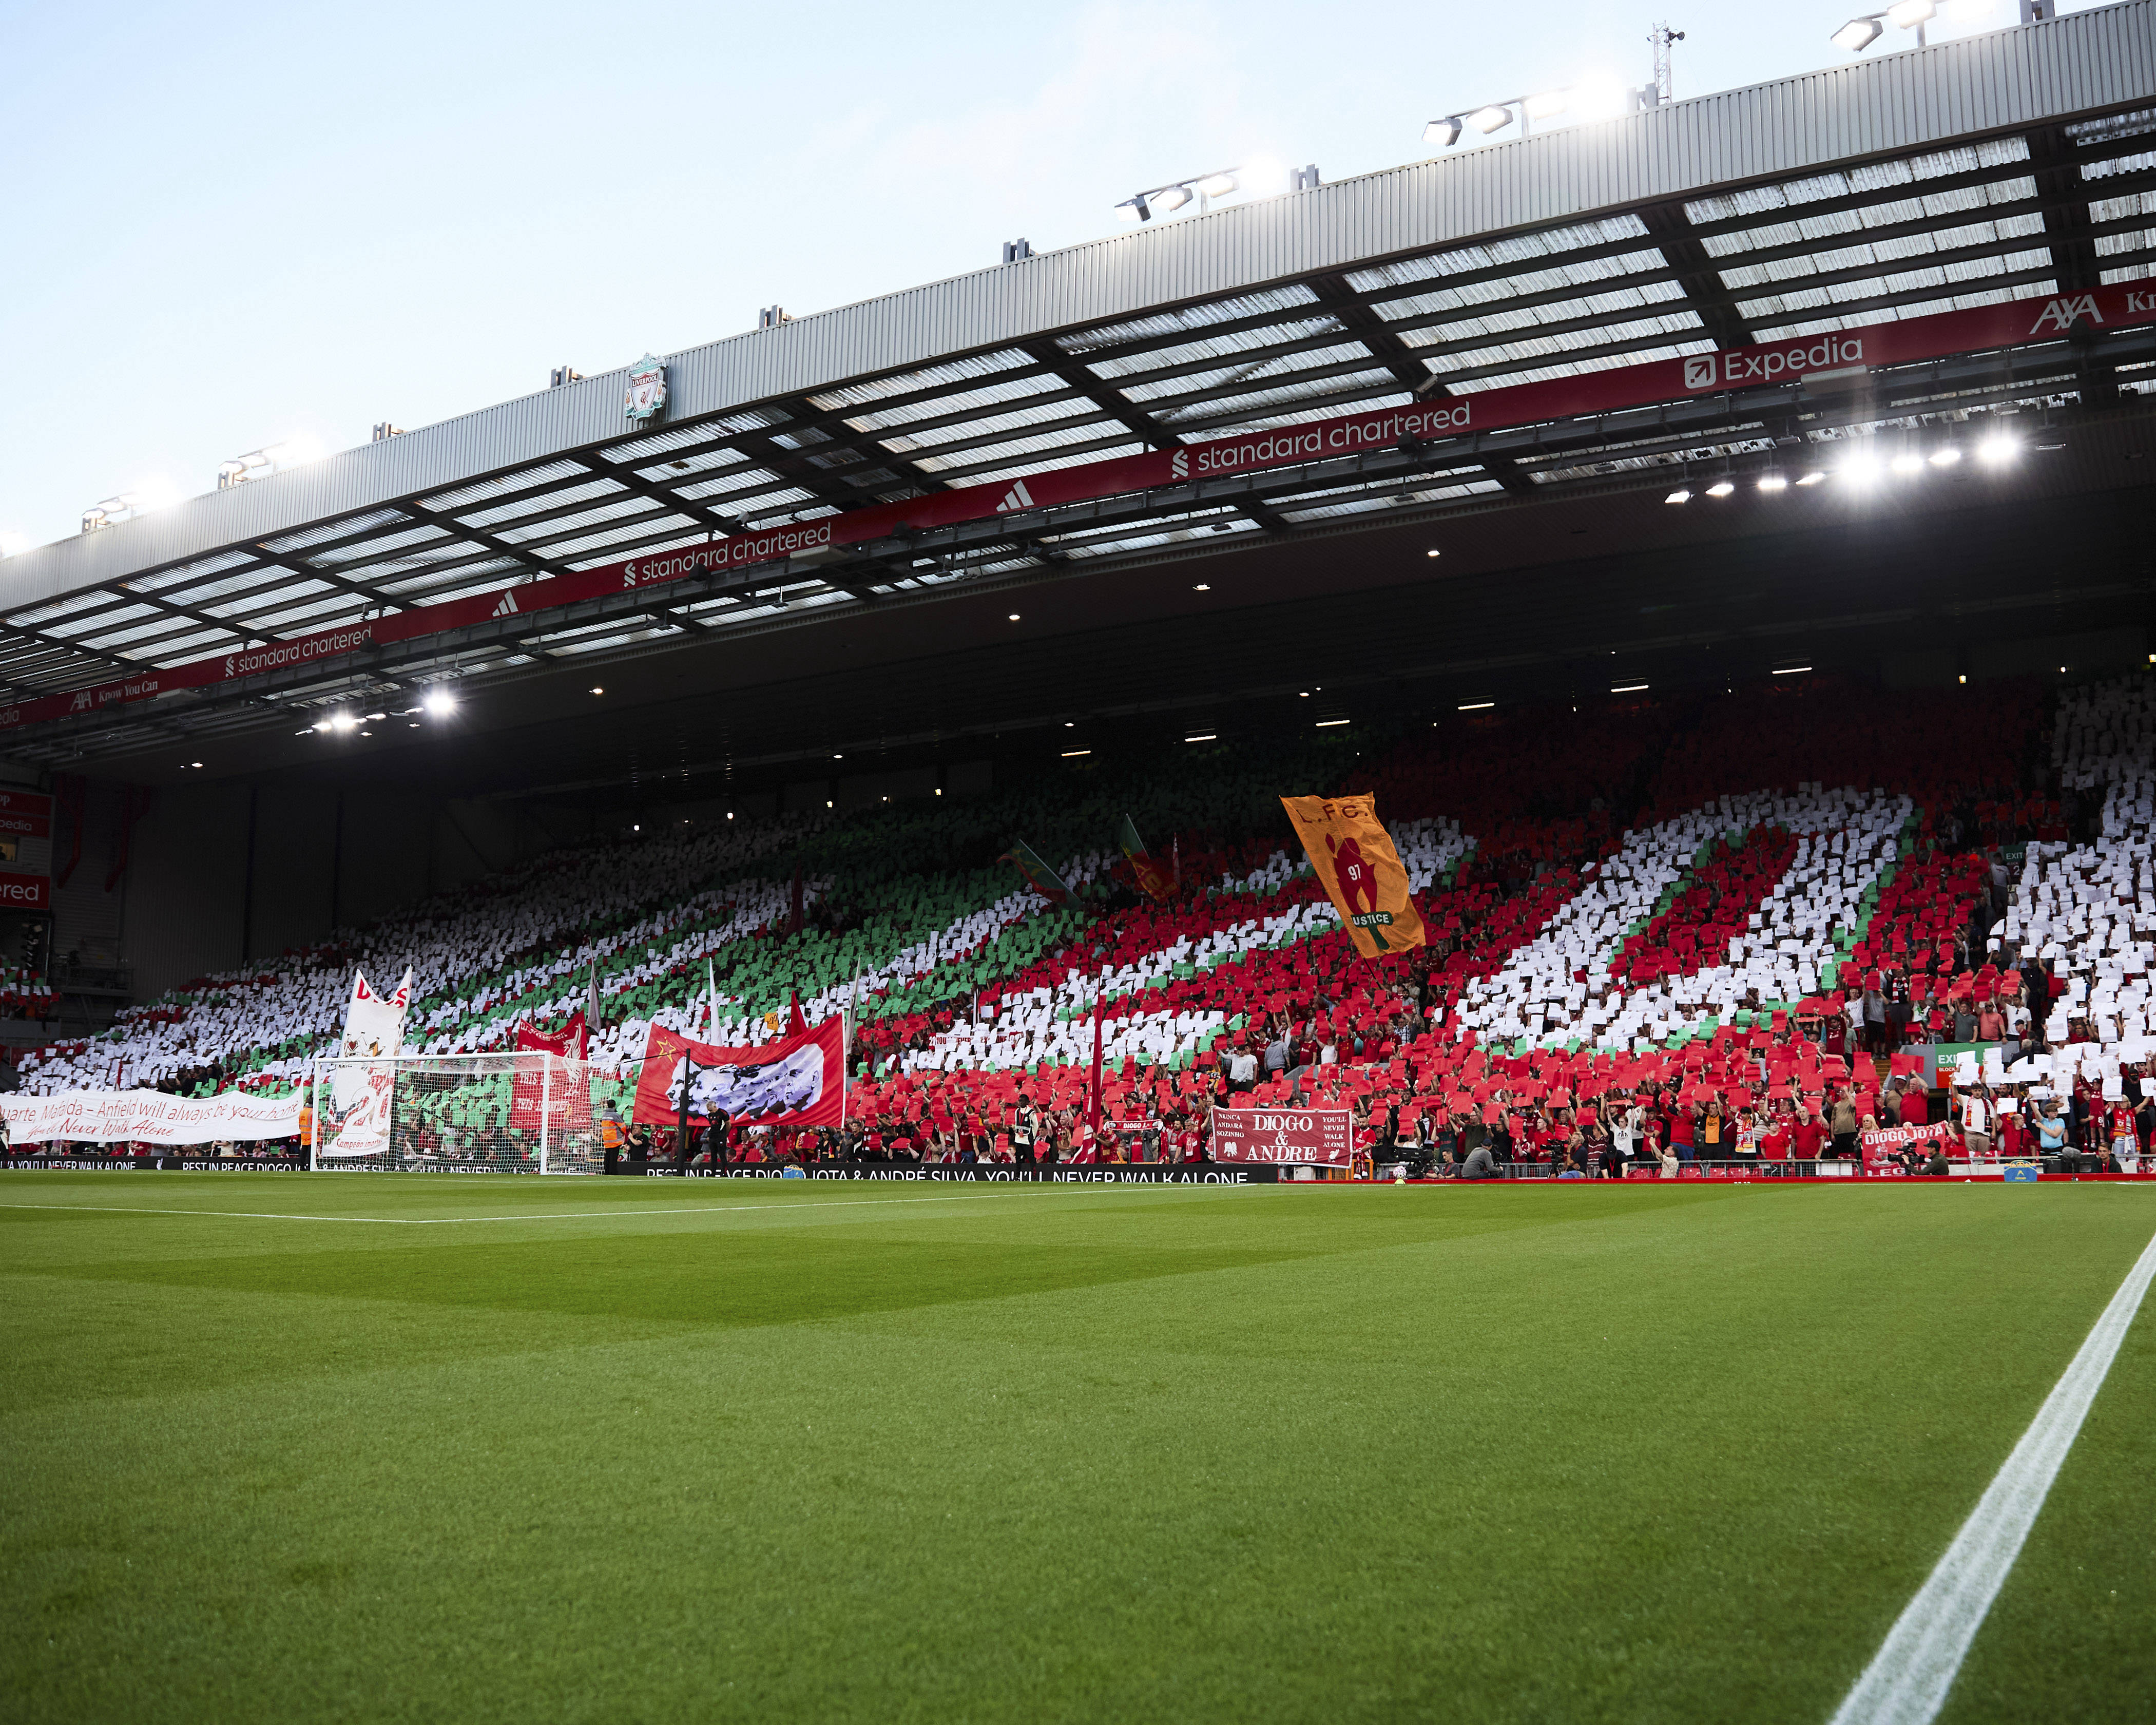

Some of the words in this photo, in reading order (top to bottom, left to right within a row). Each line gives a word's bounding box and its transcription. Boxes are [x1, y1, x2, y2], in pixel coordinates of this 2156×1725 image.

[2029, 294, 2104, 334] AXA
[1725, 336, 1863, 380] Expedia
[632, 375, 658, 387] LIVERPOOL
[1198, 427, 1322, 471] standard
[1329, 401, 1470, 448] chartered
[642, 544, 728, 581] standard
[733, 522, 831, 560] chartered
[238, 642, 299, 672] standard
[302, 625, 371, 657] chartered
[70, 691, 92, 712] AXA
[99, 687, 122, 702] Know
[125, 685, 140, 697] You
[142, 680, 158, 693] Can
[1348, 864, 1361, 881] 97
[1938, 1054, 1957, 1064] EXI
[520, 1072, 537, 1084] THIS
[97, 1098, 139, 1118] Anfield
[139, 1101, 167, 1119] will
[168, 1104, 213, 1125] always
[228, 1105, 266, 1121] your
[517, 1098, 534, 1110] THIS
[59, 1117, 100, 1135] Never
[102, 1120, 129, 1136] Walk
[131, 1119, 175, 1137] Alone
[1253, 1115, 1313, 1132] DIOGO
[1275, 1130, 1288, 1146] &
[1864, 1130, 1908, 1145] DIOGO
[1911, 1124, 1943, 1140] JOTA
[336, 1138, 364, 1149] Campeão
[1245, 1145, 1317, 1161] ANDRE
[48, 1160, 77, 1170] NEVER
[79, 1161, 103, 1170] WALK
[105, 1161, 136, 1171] ALONE
[182, 1162, 207, 1171] REST
[209, 1162, 219, 1171] IN
[222, 1162, 254, 1171] PEACE
[257, 1163, 292, 1172] DIOGO
[685, 1169, 699, 1177] IN
[854, 1170, 864, 1180] &
[870, 1166, 927, 1180] ANDRÉ
[931, 1171, 976, 1181] SILVA
[1053, 1172, 1114, 1182] NEVER
[1120, 1172, 1175, 1183] WALK
[1181, 1173, 1248, 1184] ALONE
